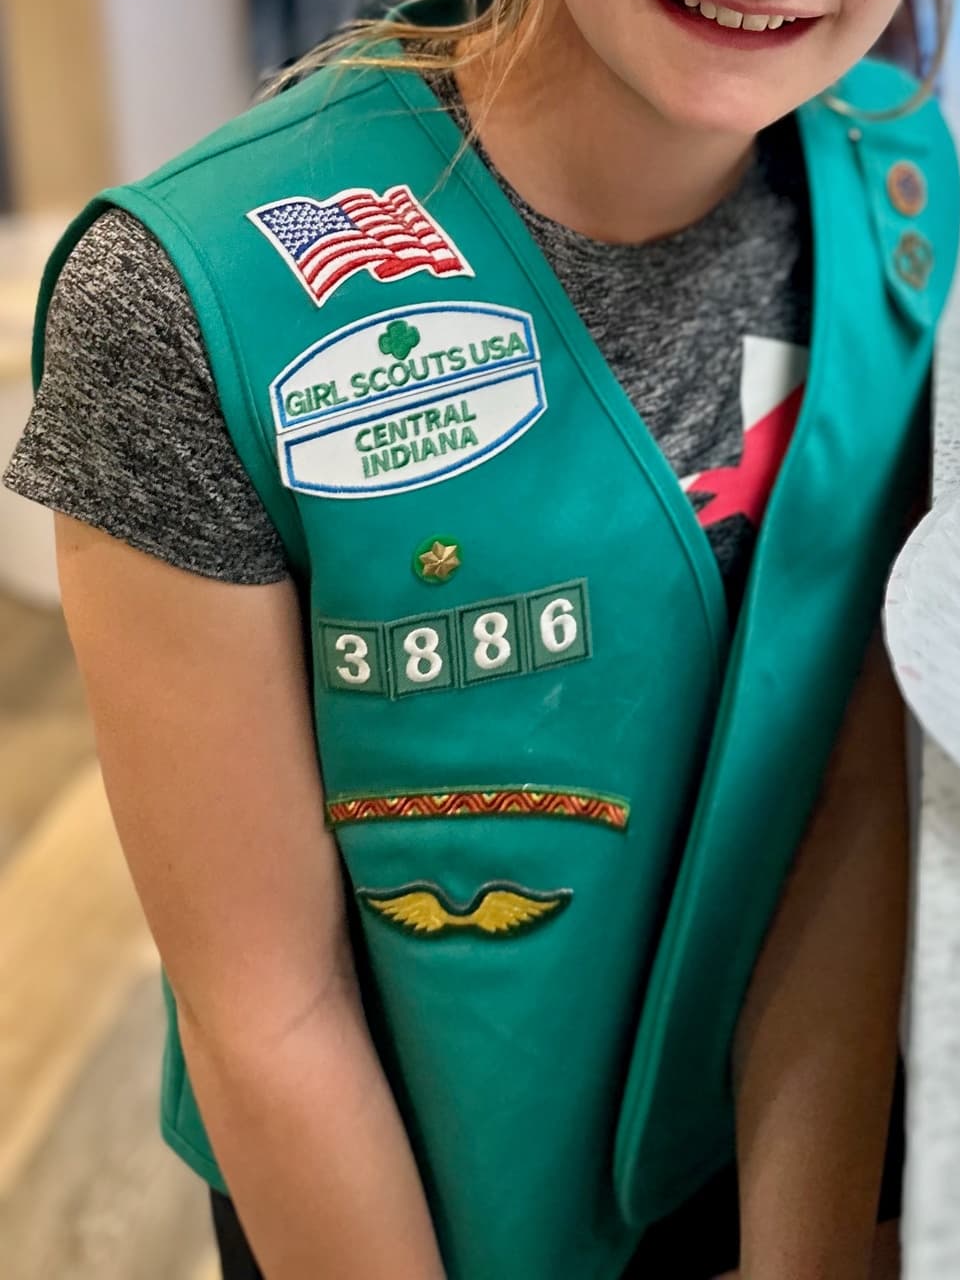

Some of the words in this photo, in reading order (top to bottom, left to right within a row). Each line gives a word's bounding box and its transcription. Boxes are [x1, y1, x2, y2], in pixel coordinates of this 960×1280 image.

[285, 380, 348, 417] GIRL
[350, 347, 466, 394] SCOUTS
[470, 332, 527, 366] USA
[355, 400, 476, 453] CENTRAL
[361, 426, 478, 478] INDIANA
